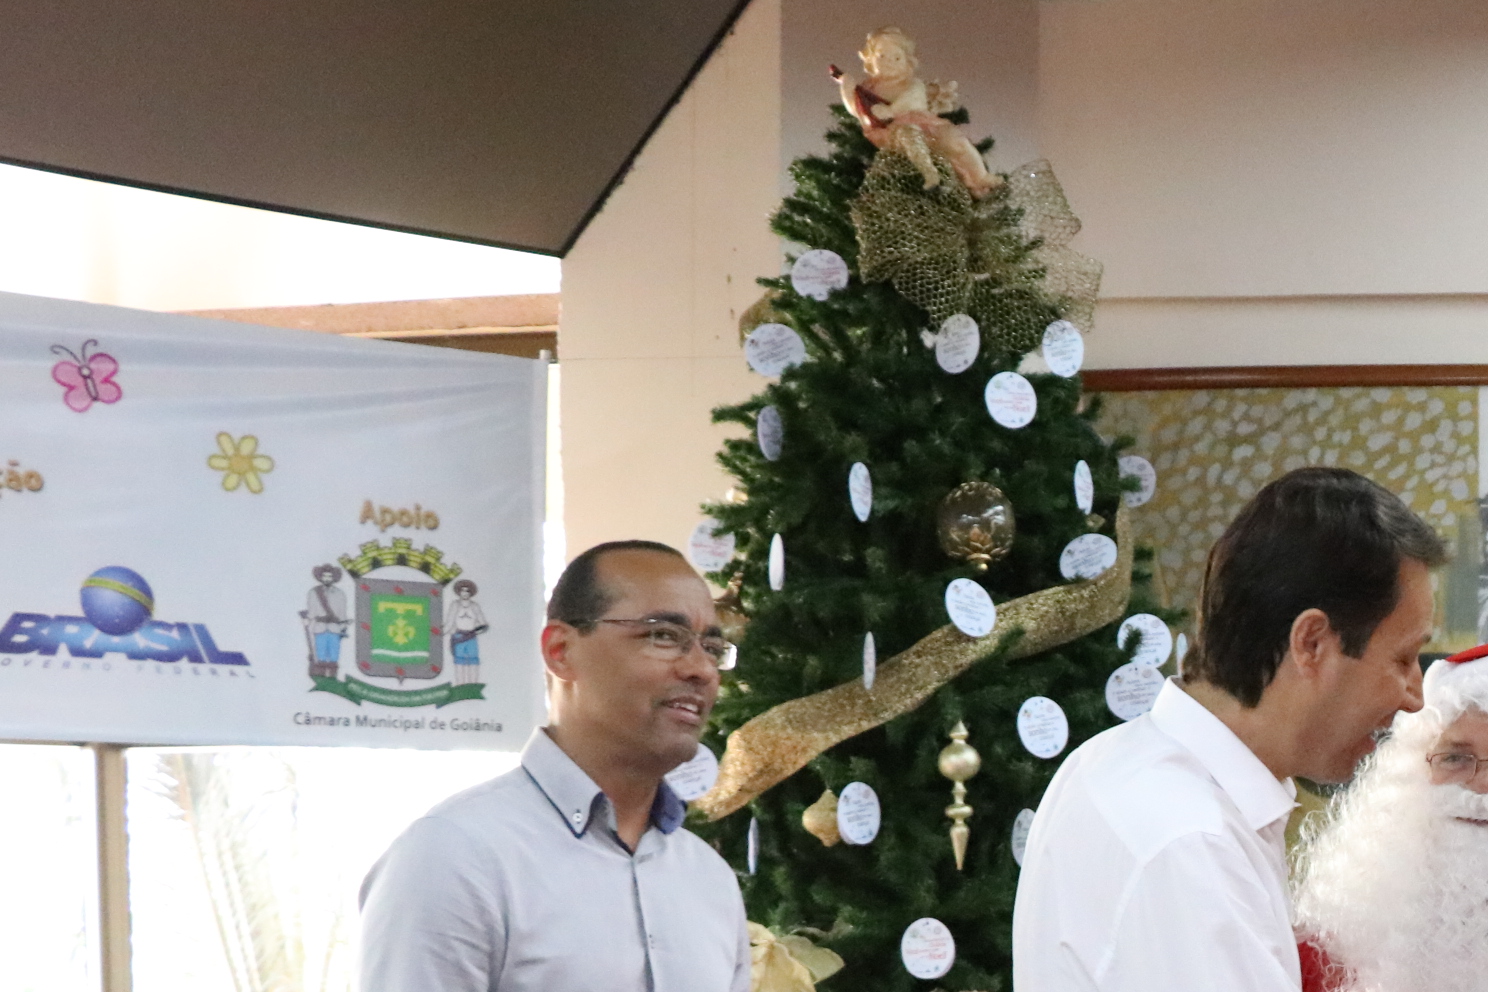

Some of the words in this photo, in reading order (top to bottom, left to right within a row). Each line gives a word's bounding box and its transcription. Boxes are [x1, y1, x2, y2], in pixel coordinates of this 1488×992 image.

[0, 458, 45, 496] ão
[359, 499, 440, 532] Apoio
[0, 612, 250, 666] BRASIL
[293, 711, 351, 727] Câmara
[355, 715, 425, 732] Municipal
[429, 717, 447, 730] de
[450, 717, 503, 733] Goiânia
